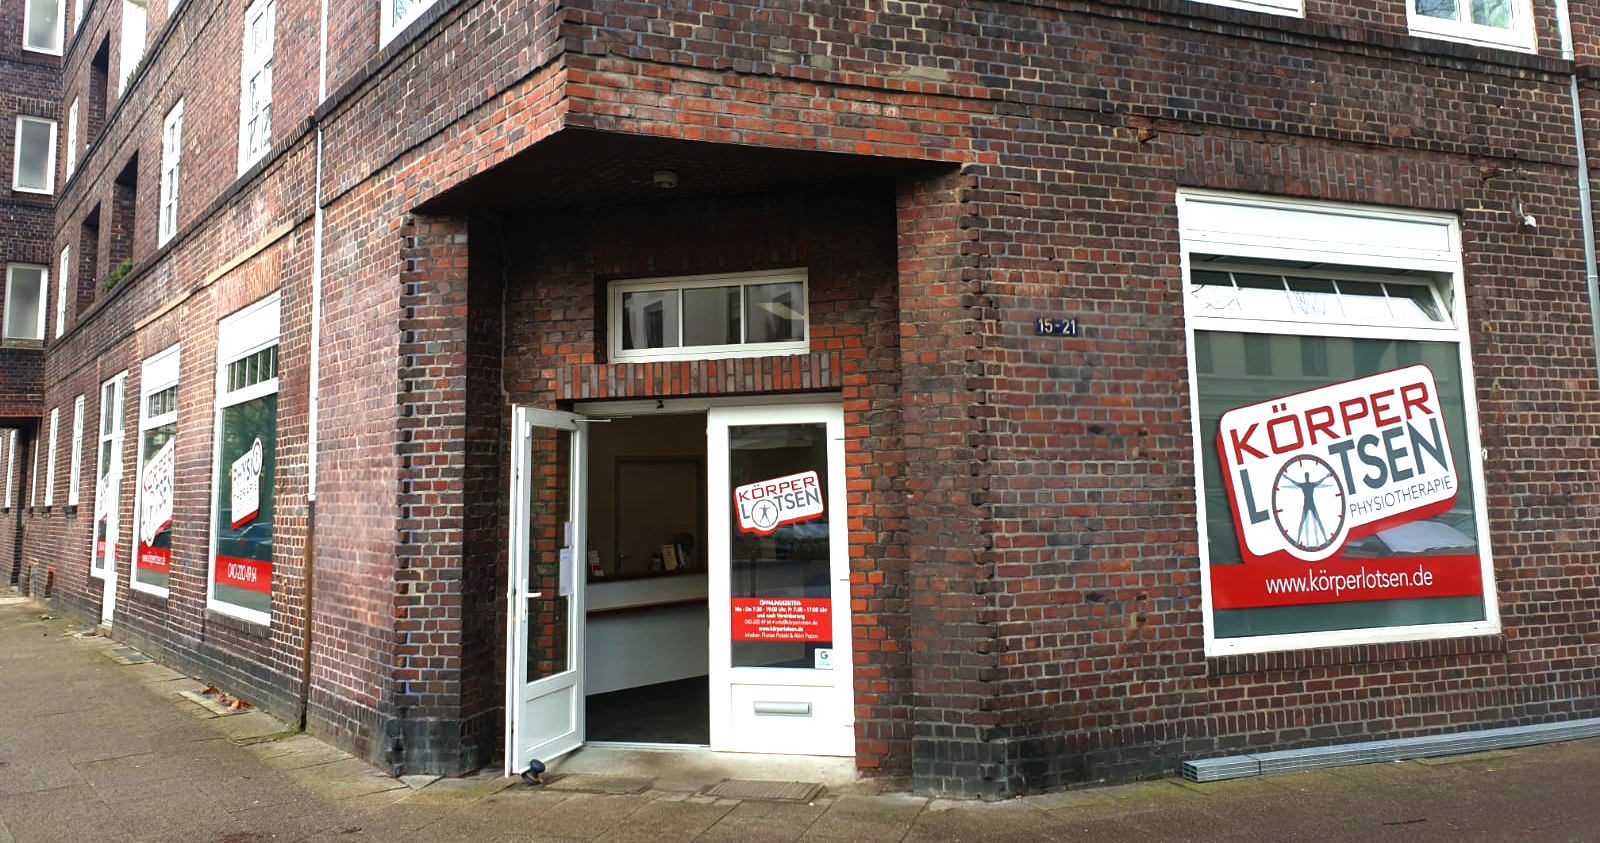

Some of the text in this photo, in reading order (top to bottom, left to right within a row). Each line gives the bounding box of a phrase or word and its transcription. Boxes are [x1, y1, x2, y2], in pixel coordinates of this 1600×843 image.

[1230, 382, 1434, 465] KÖRPER
[739, 476, 816, 502] KÖRPER
[1350, 476, 1453, 518] PHYSIOTHERAPIE
[1266, 565, 1433, 596] www.körperlotsen.de
